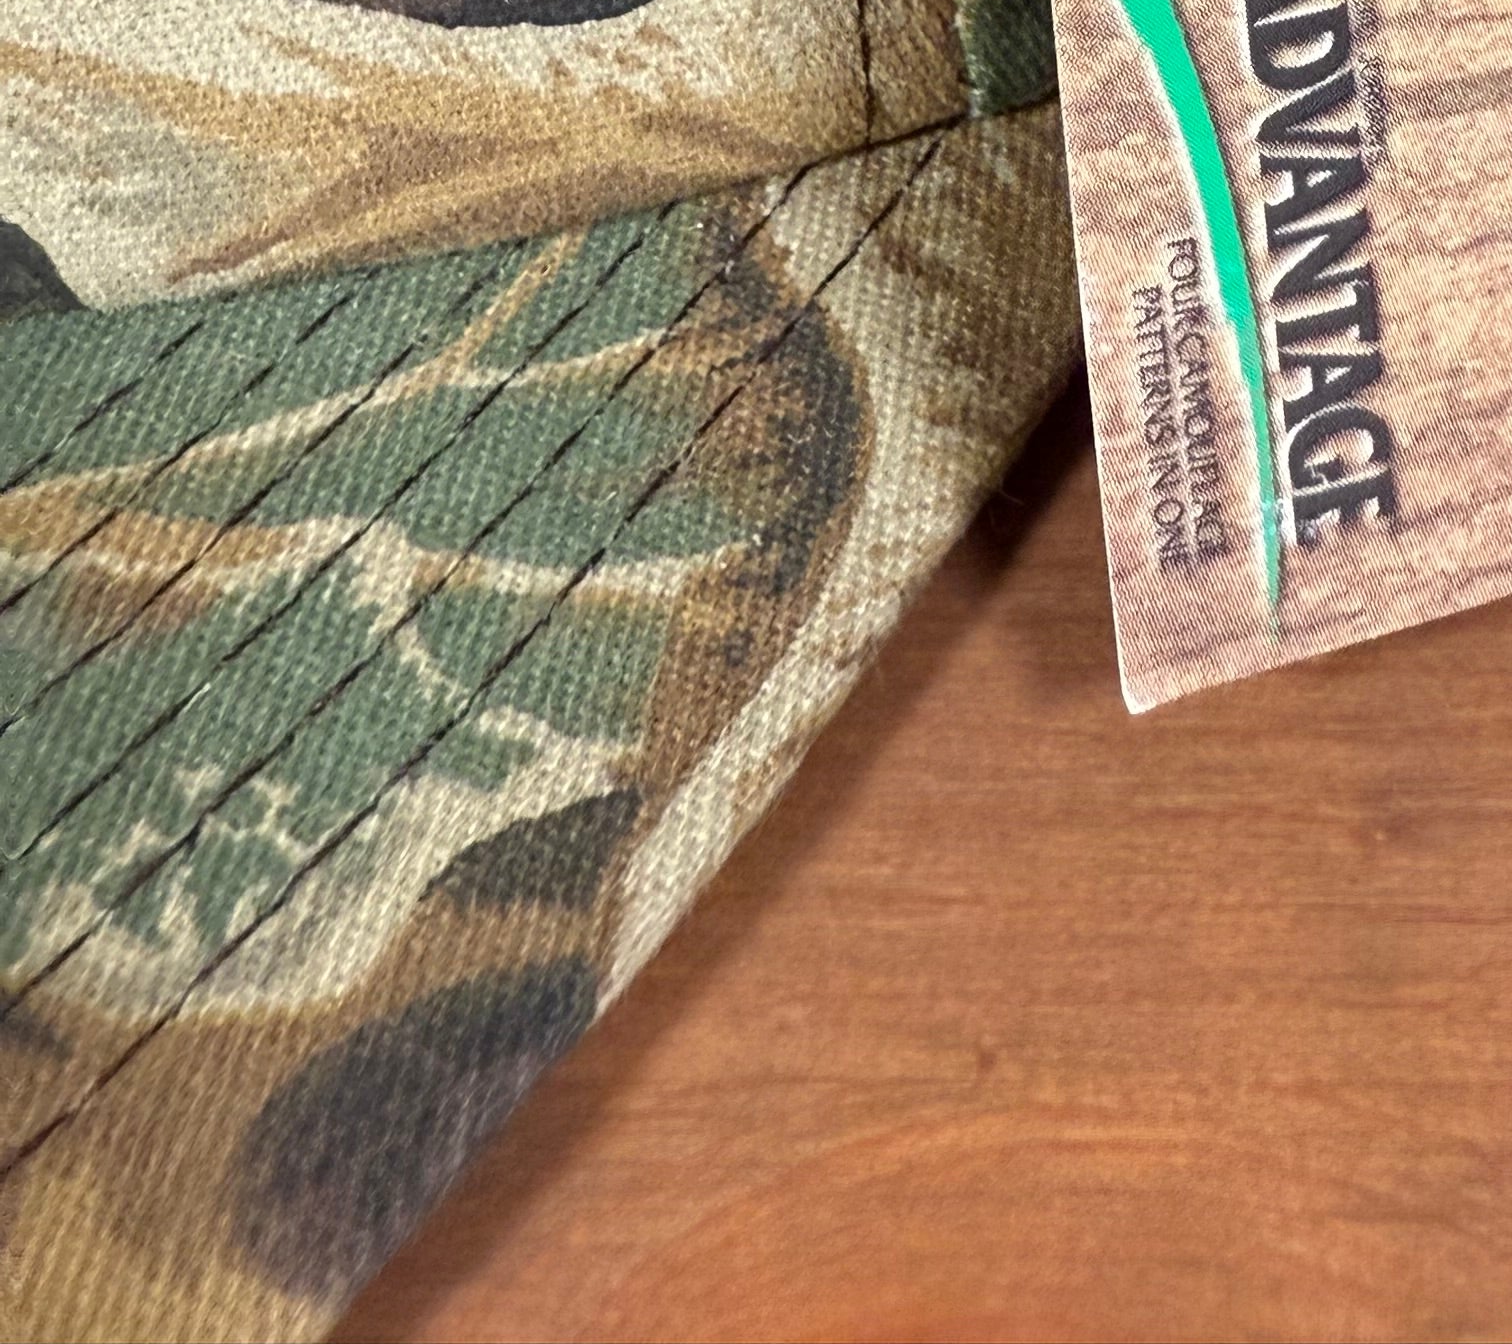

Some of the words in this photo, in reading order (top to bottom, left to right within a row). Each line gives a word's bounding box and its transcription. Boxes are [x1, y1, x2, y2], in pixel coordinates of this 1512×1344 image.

[1166, 236, 1208, 331] FOUR
[1130, 284, 1180, 450] PATTERNS
[1147, 453, 1182, 495] IN
[1153, 497, 1194, 571] ONE
